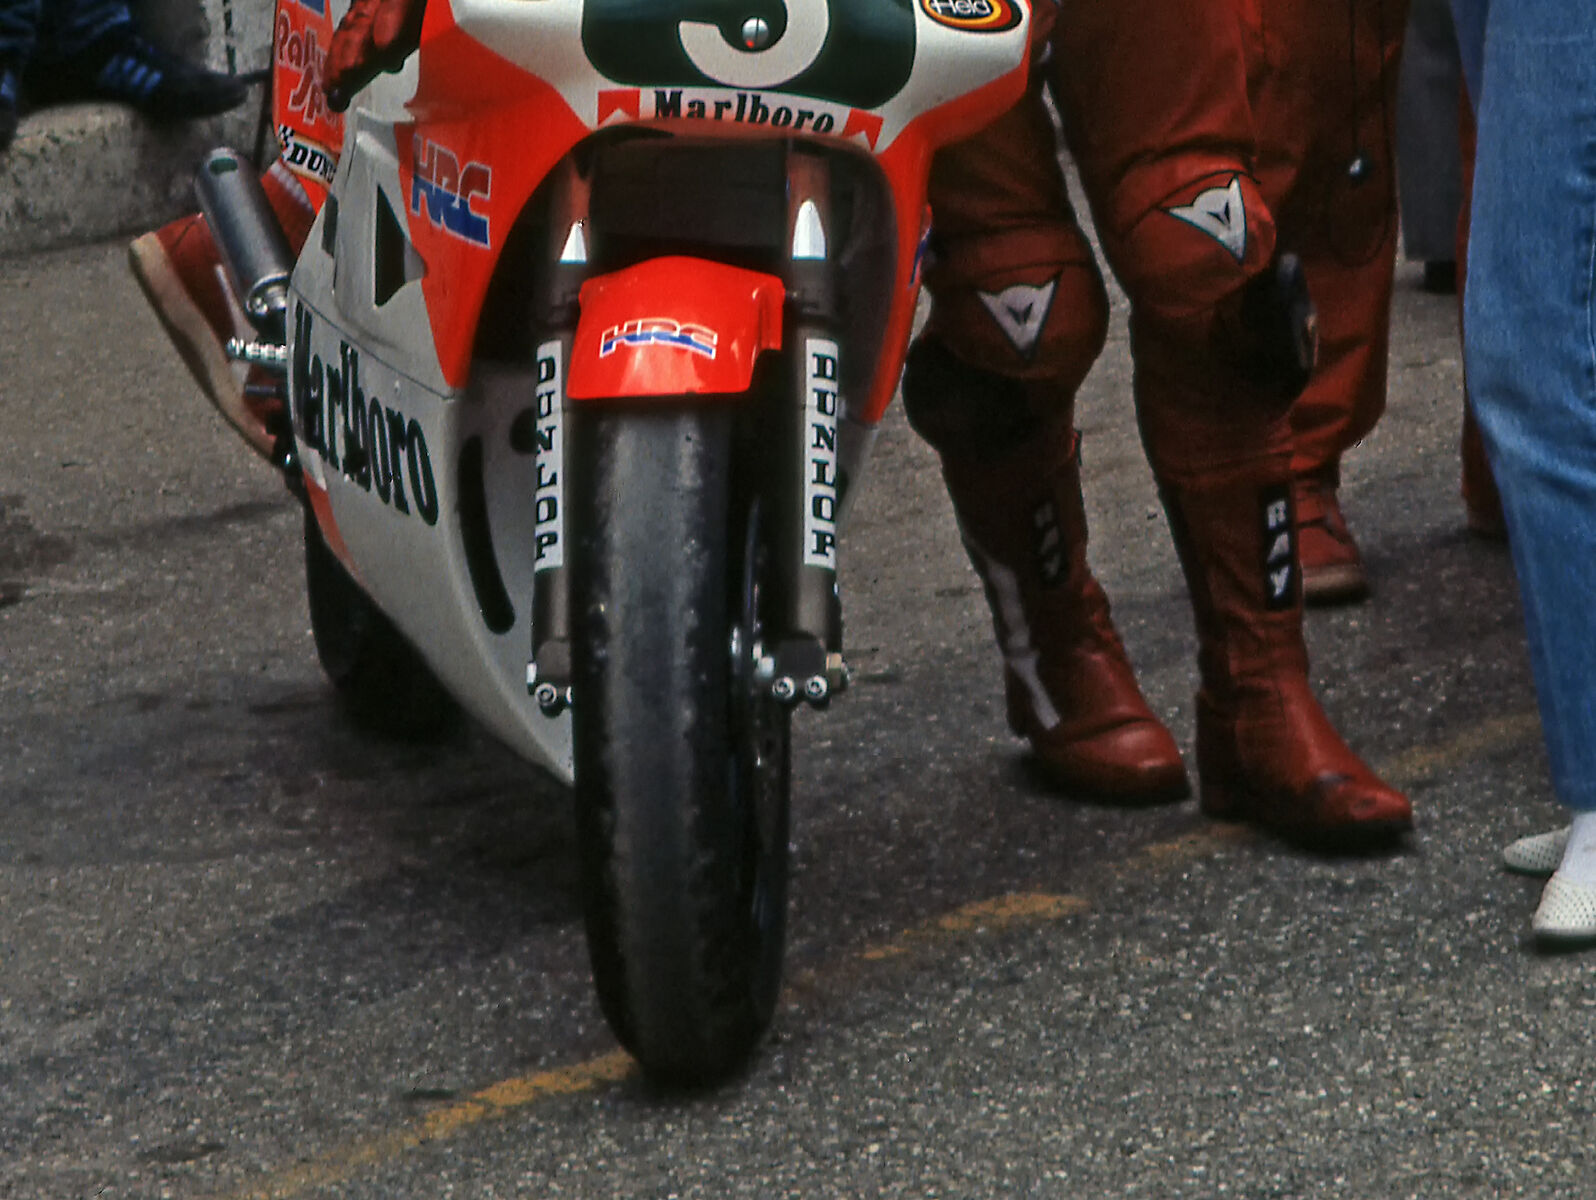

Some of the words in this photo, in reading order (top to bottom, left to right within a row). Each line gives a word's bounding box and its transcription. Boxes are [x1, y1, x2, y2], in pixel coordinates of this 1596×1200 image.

[411, 133, 491, 249] HRC
[654, 90, 834, 134] Marlboro
[535, 356, 559, 560] DUNLOP
[811, 353, 837, 558] DUNLOP
